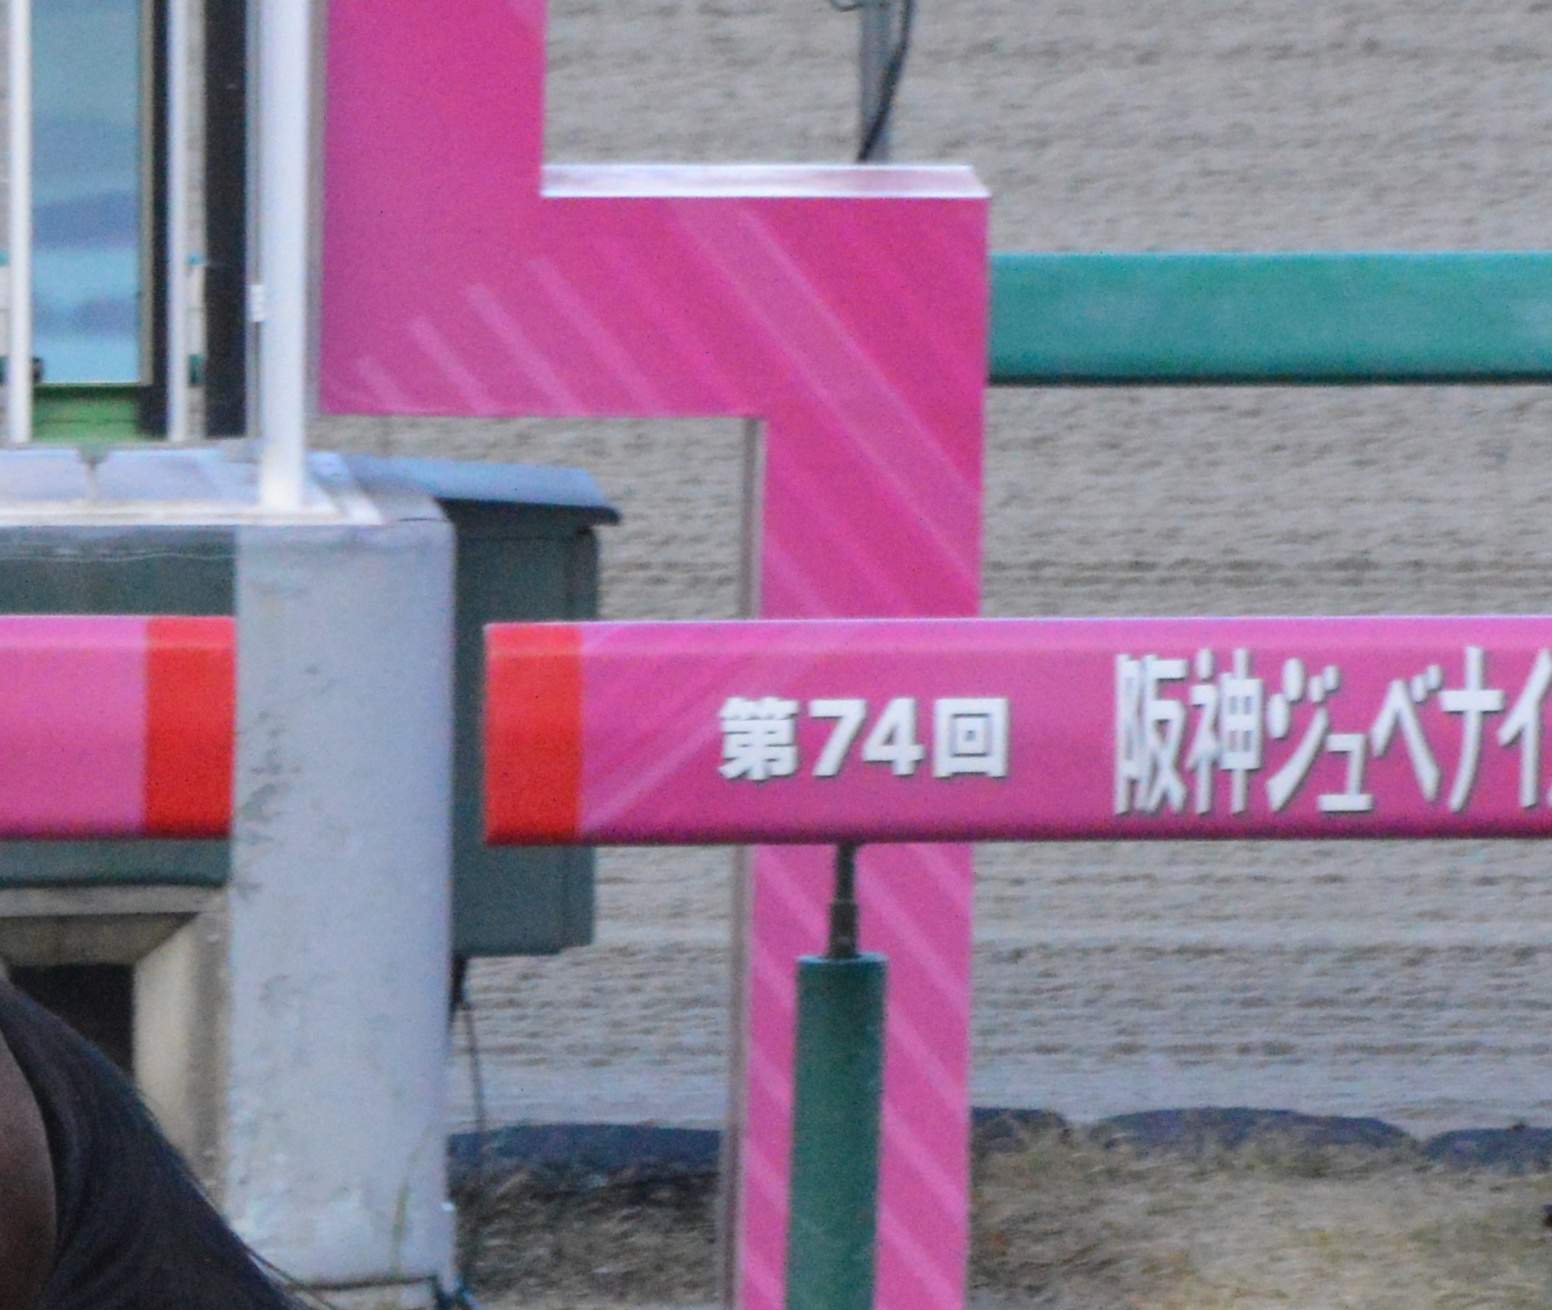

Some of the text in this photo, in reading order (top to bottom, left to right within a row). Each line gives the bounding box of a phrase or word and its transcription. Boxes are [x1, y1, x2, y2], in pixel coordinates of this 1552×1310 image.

[717, 645, 1552, 815] 第74回 阪神ジュベナイ
